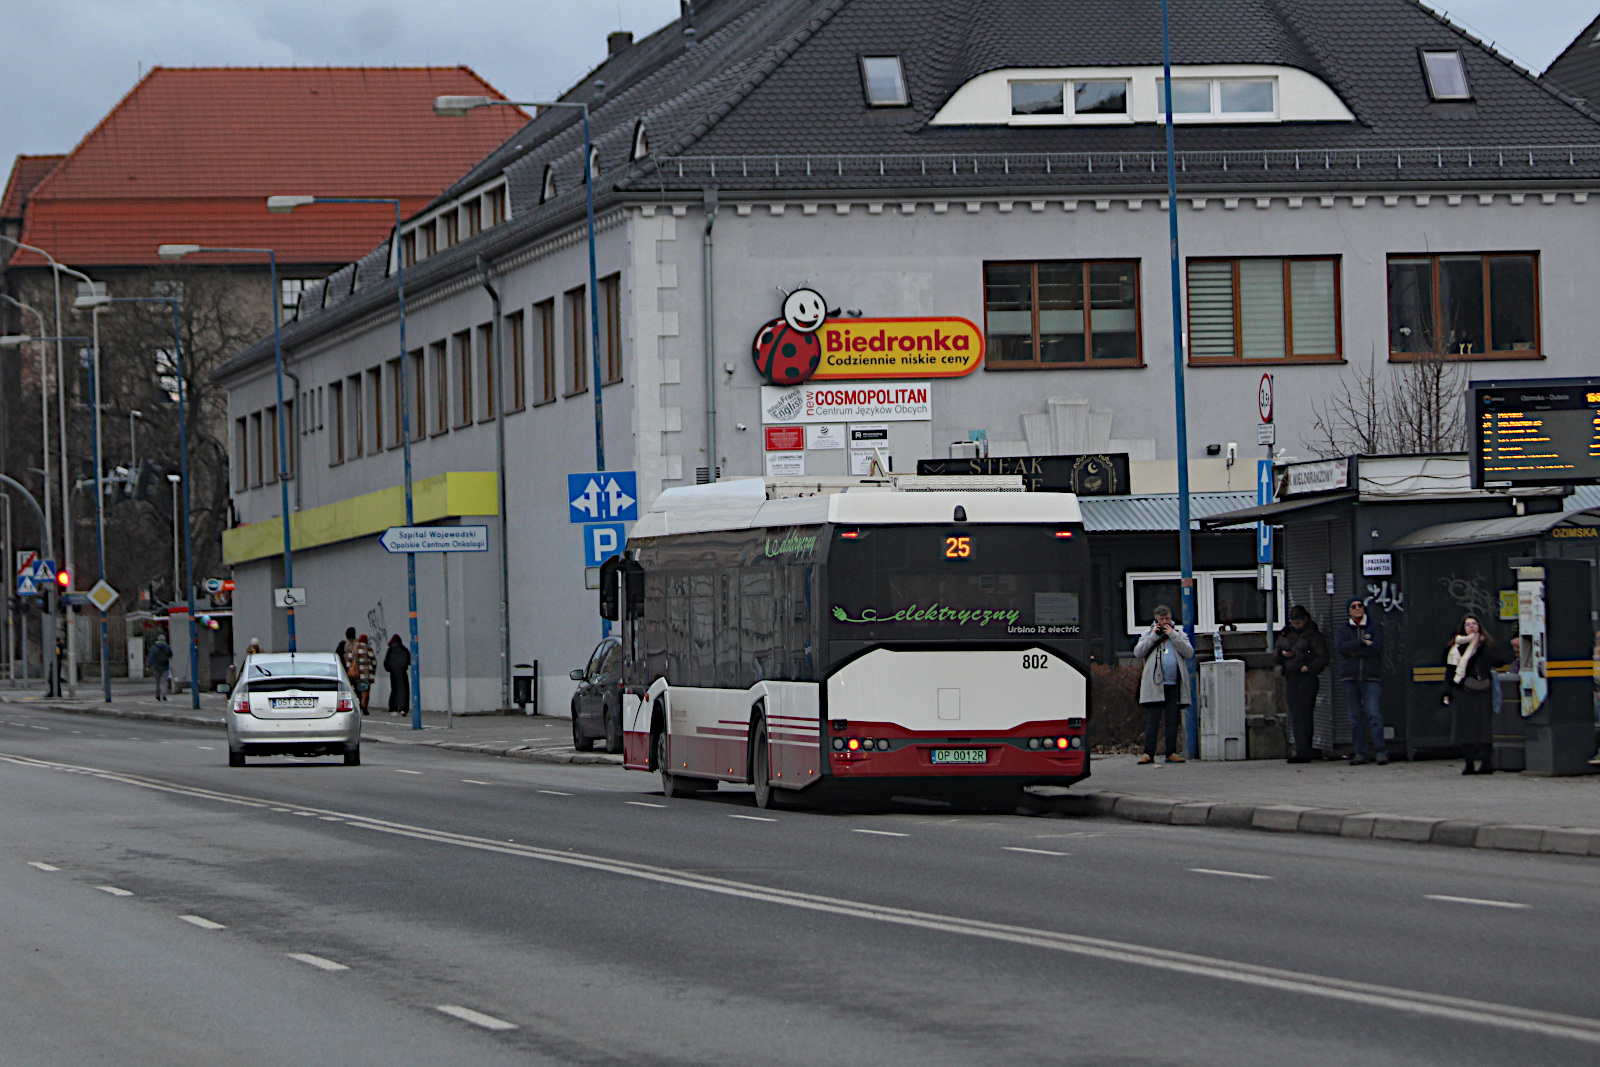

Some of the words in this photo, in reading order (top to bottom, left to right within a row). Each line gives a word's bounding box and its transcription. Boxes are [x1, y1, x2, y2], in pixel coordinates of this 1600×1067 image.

[826, 328, 970, 352] Biedronka
[827, 354, 896, 366] Codziennie
[901, 352, 937, 365] niskie
[941, 354, 970, 366] ceny
[806, 391, 815, 416] new
[815, 388, 927, 406] COSMOPOLITAN
[772, 396, 803, 419] English
[815, 405, 853, 416] Centrum
[855, 404, 892, 416] Języków
[894, 402, 928, 415] Obcych
[969, 457, 1043, 475] STEAK
[398, 530, 427, 539] Szpital
[1552, 527, 1599, 538] OZIMSKA
[390, 540, 420, 550] Opolskie
[421, 540, 450, 549] Centrum
[451, 539, 485, 549] Onkologii
[593, 528, 618, 562] P
[945, 537, 971, 558] 25
[895, 603, 1020, 627] elektryczny
[1007, 625, 1036, 634] Urbino
[1037, 625, 1045, 633] 12
[1047, 625, 1080, 633] electric
[1022, 654, 1048, 669] 802
[937, 750, 950, 761] OP
[953, 750, 984, 761] 0012R
